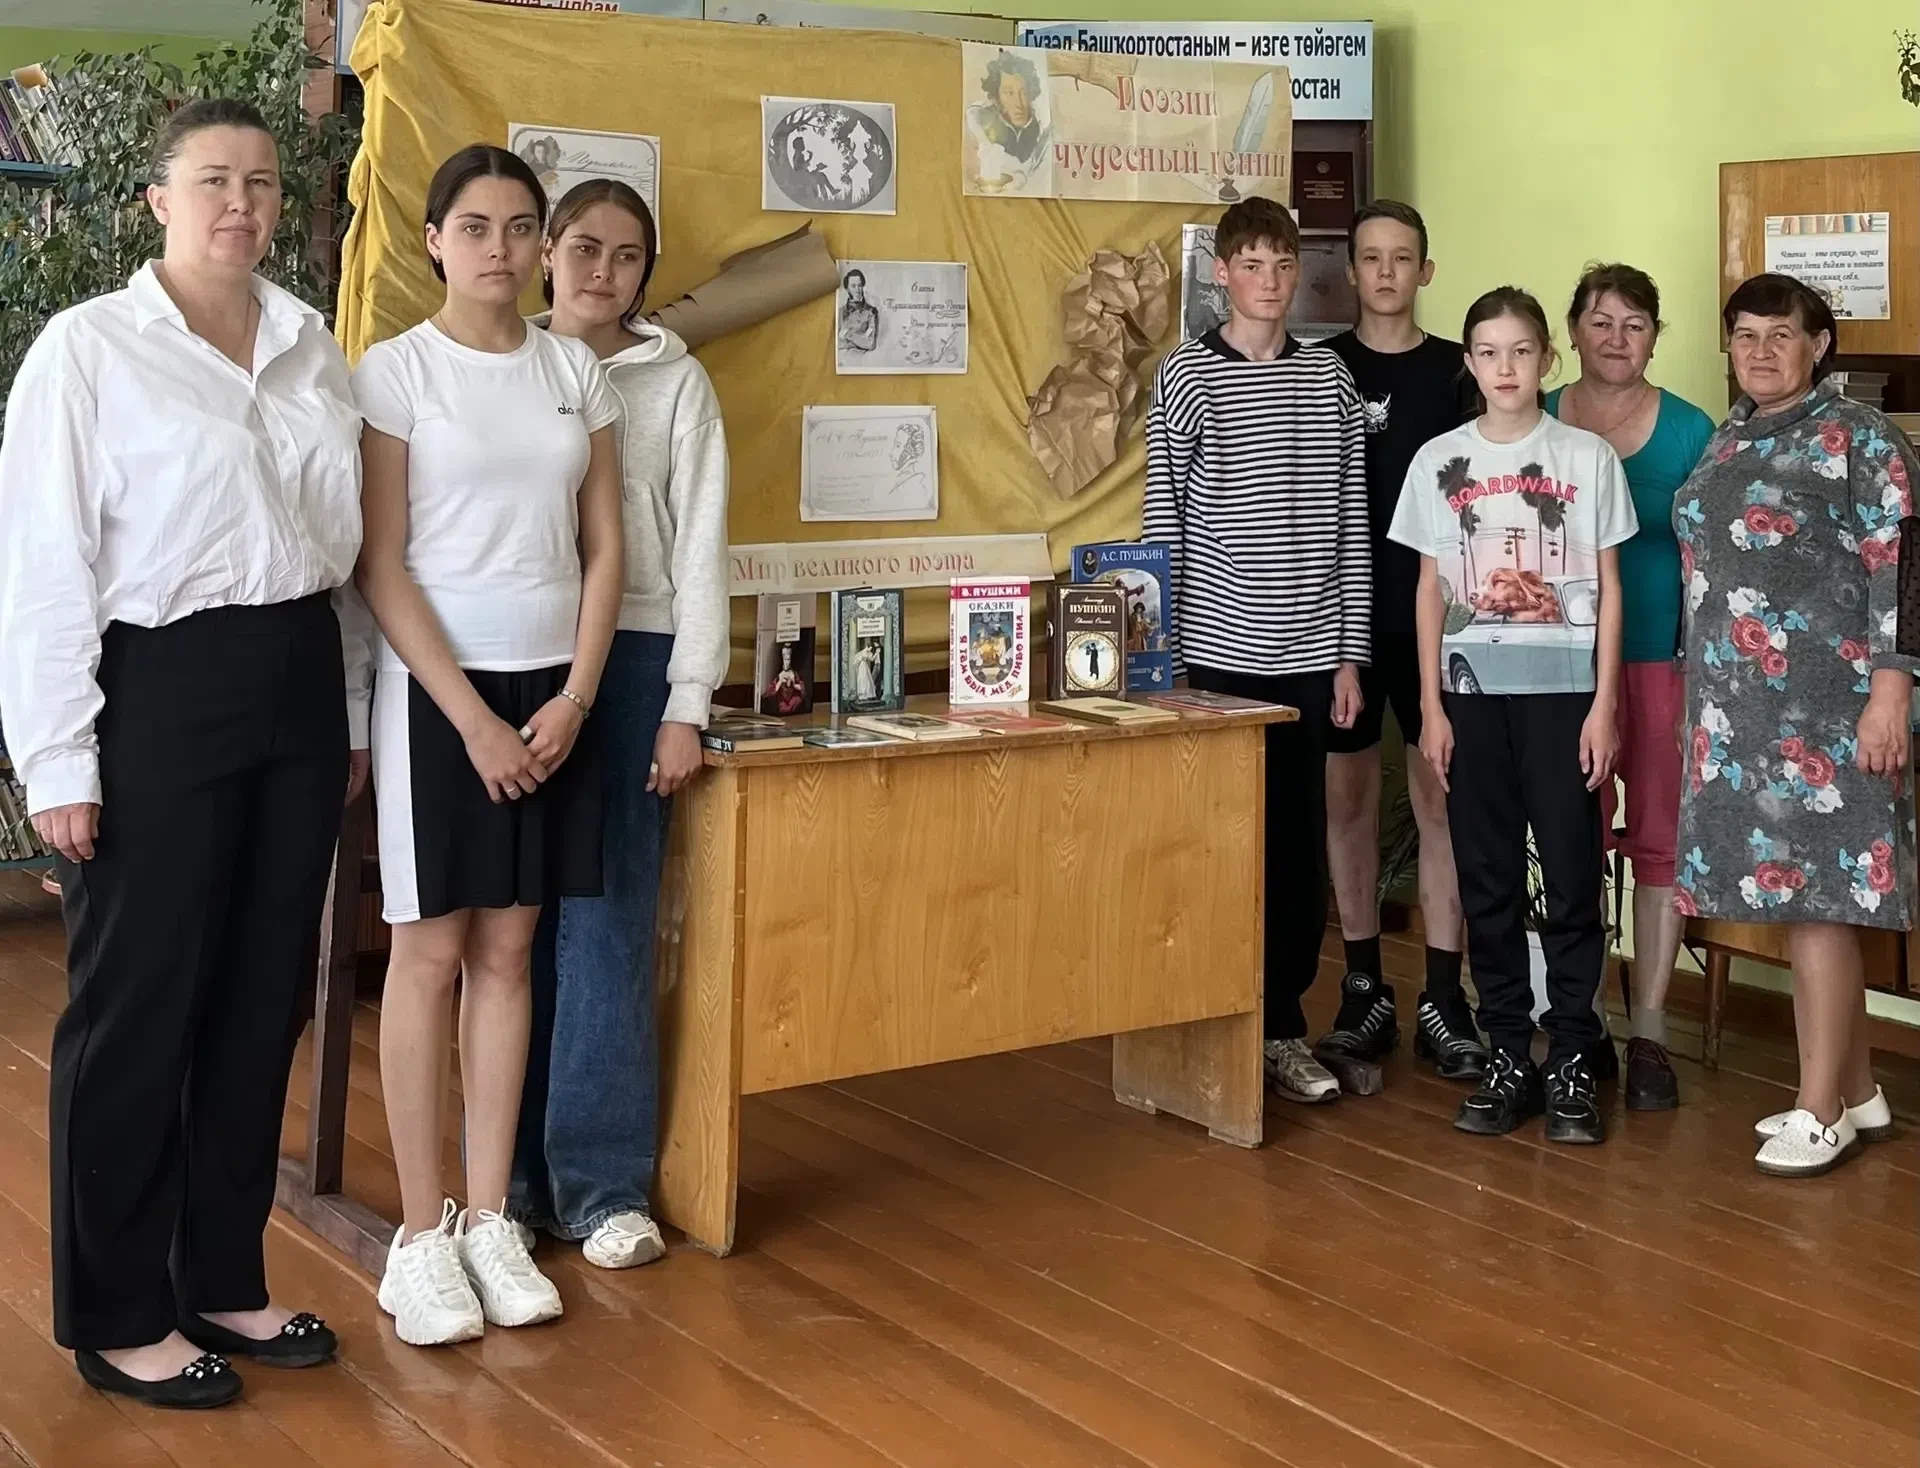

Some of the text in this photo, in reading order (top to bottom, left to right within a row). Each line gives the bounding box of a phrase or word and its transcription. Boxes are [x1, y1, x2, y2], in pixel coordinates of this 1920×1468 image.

[1251, 35, 1289, 57] изге
[1294, 27, 1366, 57] төйәгем
[1289, 77, 1341, 100] остан
[1054, 141, 1288, 181] чудесный гений
[911, 281, 918, 292] 6
[1447, 474, 1578, 513] BOARDWALK
[1100, 549, 1164, 562] А.С. ПУШКИН
[732, 553, 976, 585] Мир великого поэта
[973, 586, 1022, 597] ПУШКИН
[969, 601, 1014, 611] СКАЗКИ
[1069, 604, 1116, 614] ПУШКИН
[960, 635, 968, 644] Я
[1011, 643, 1024, 679] ПИВО
